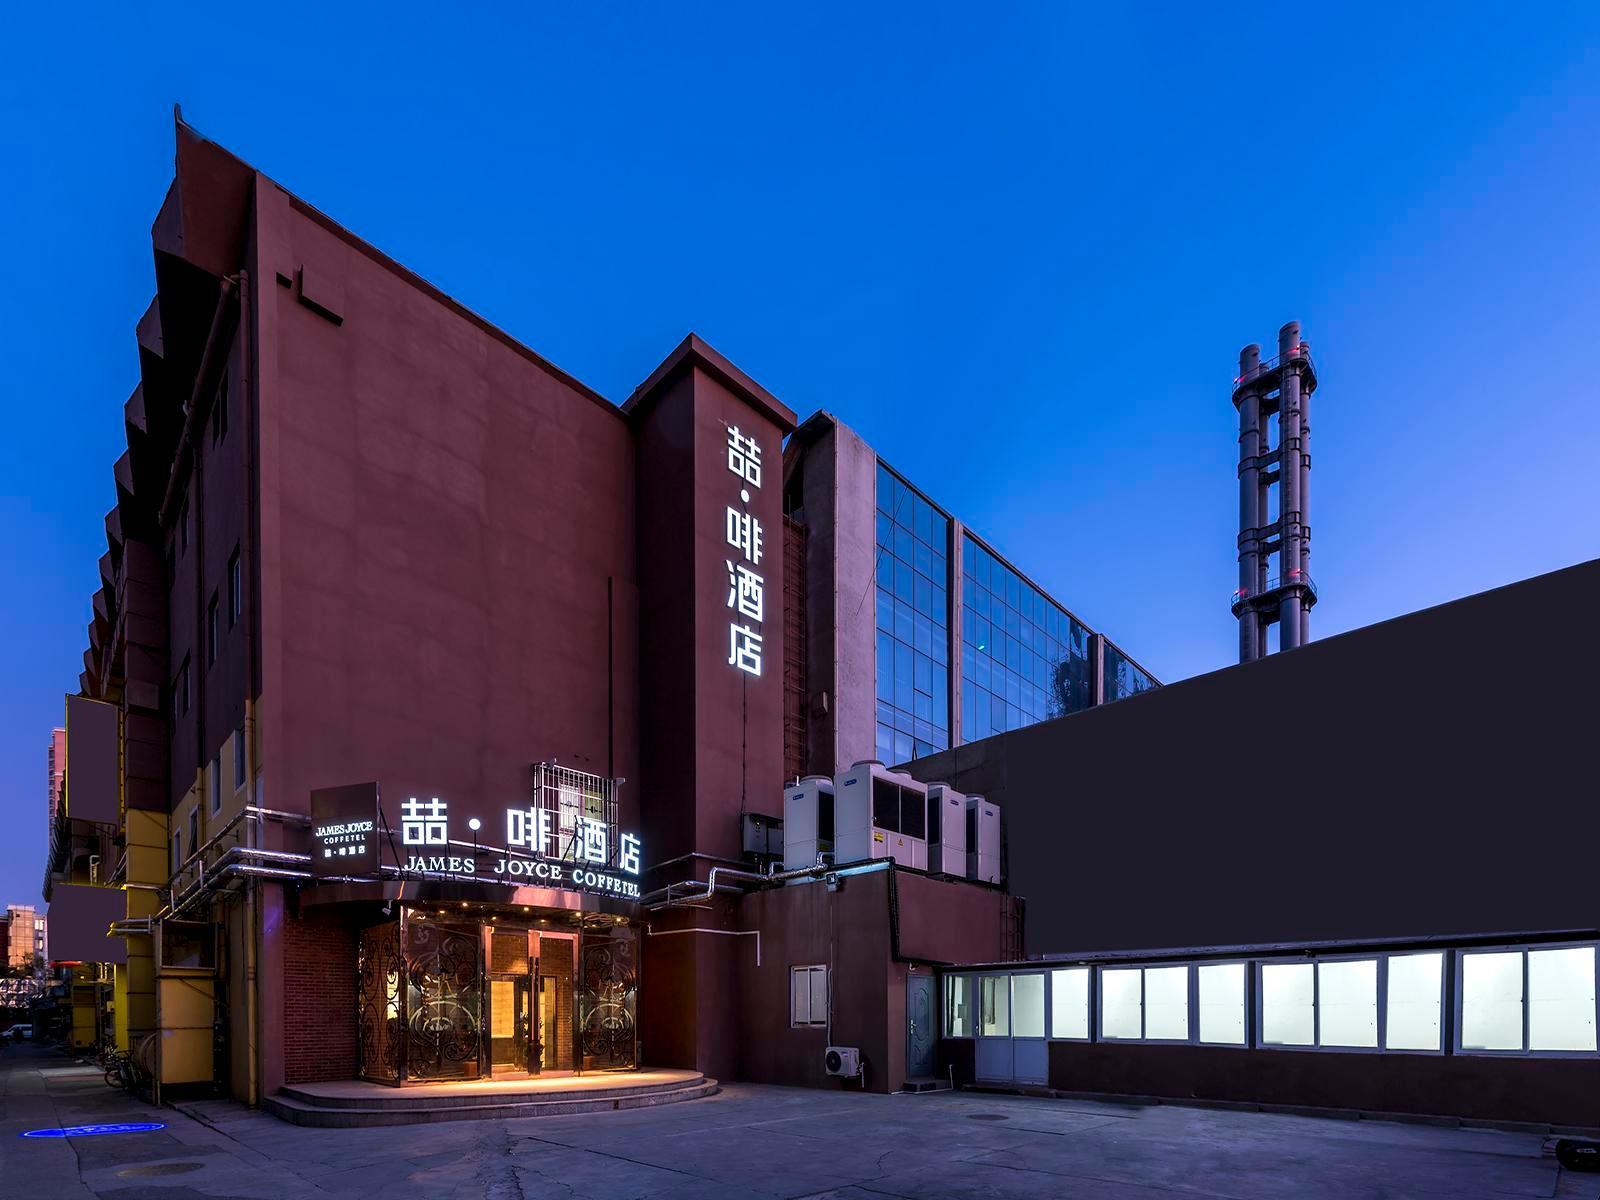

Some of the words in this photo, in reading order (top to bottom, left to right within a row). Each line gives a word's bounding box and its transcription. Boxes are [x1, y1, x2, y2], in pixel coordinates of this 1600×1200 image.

[315, 825, 345, 837] JAMES
[345, 821, 373, 833] JOYCE
[323, 834, 366, 844] COFFETEL
[404, 856, 475, 873] JAMES
[494, 859, 562, 880] JOYCE
[572, 869, 641, 898] COFFETEL
